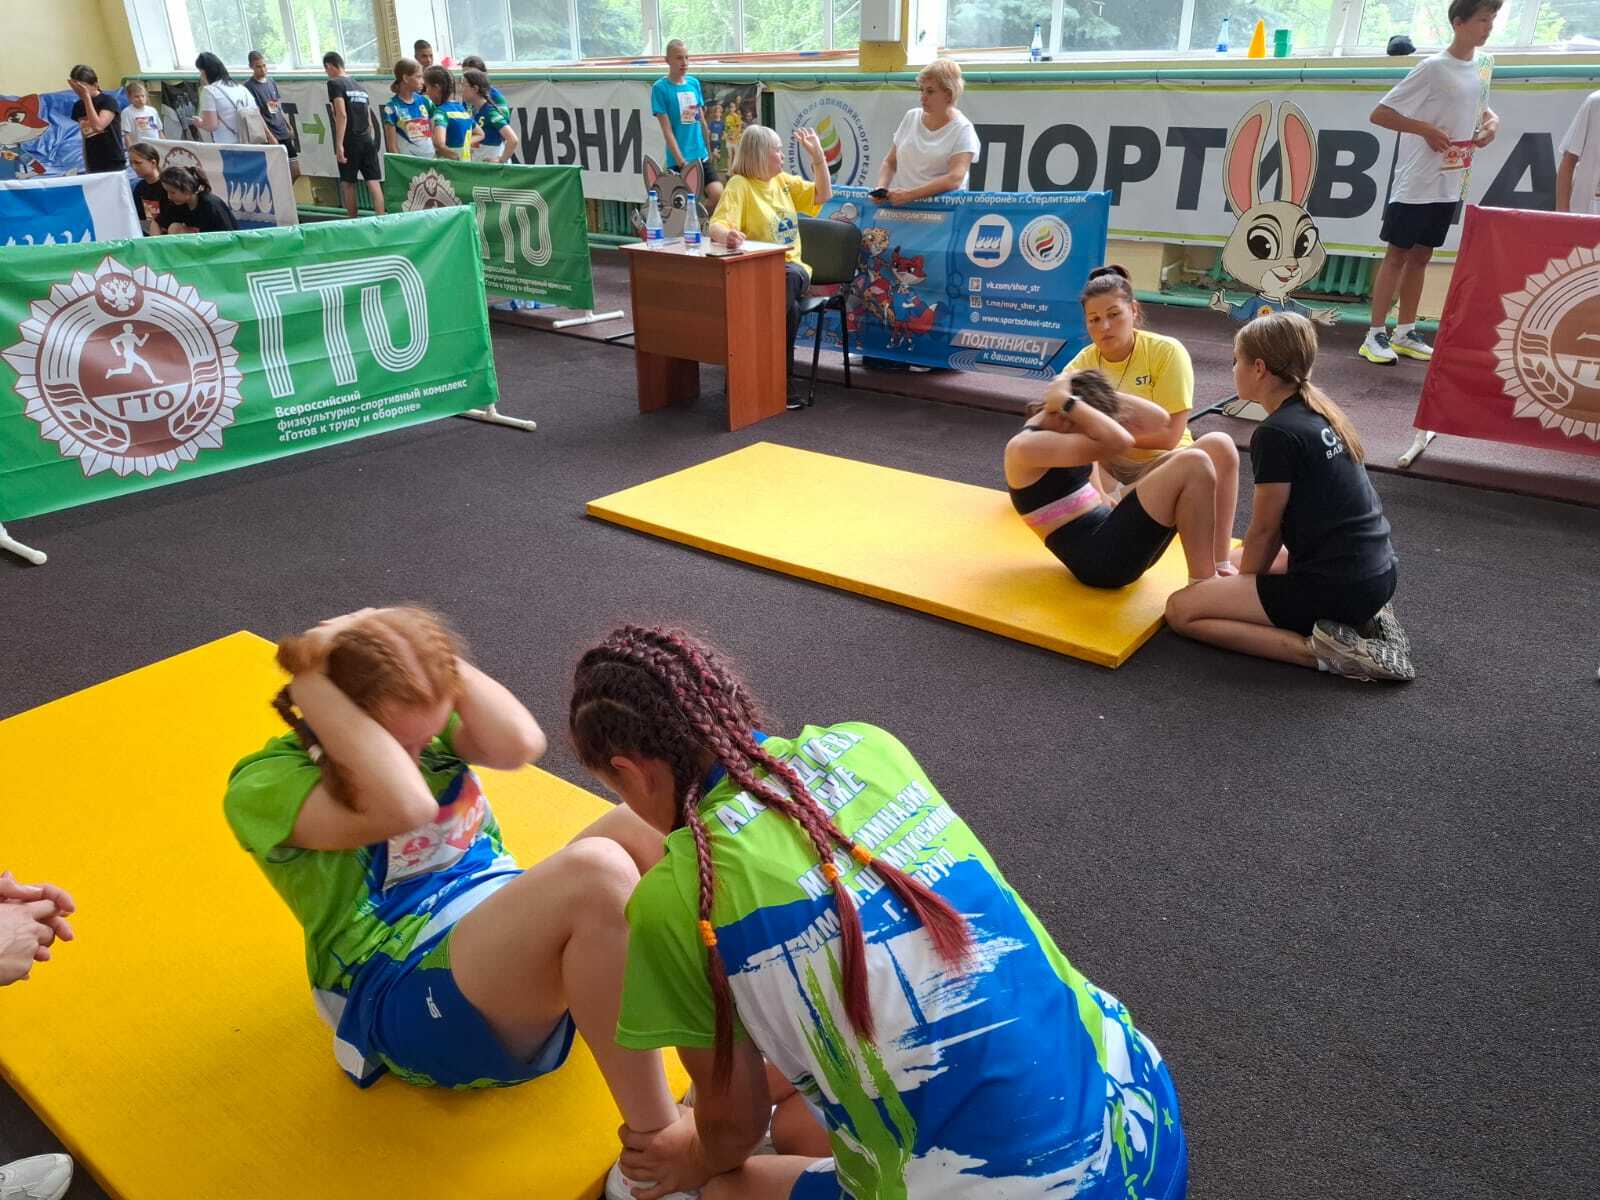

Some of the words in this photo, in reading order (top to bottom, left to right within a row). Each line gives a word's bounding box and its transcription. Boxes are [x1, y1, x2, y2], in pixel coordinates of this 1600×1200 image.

[507, 106, 642, 174] ИЗНИ
[246, 254, 429, 398] ГТО
[117, 390, 175, 417] ГТО
[275, 390, 361, 418] Всероссийский
[277, 388, 421, 432] физкультурно-спортивный
[422, 379, 468, 397] комплекс
[279, 426, 318, 442] «Готов
[320, 424, 328, 434] к
[329, 417, 361, 433] труду
[363, 414, 370, 423] и
[372, 402, 421, 421] обороне»
[850, 779, 933, 850] ИМНАЗИЯ
